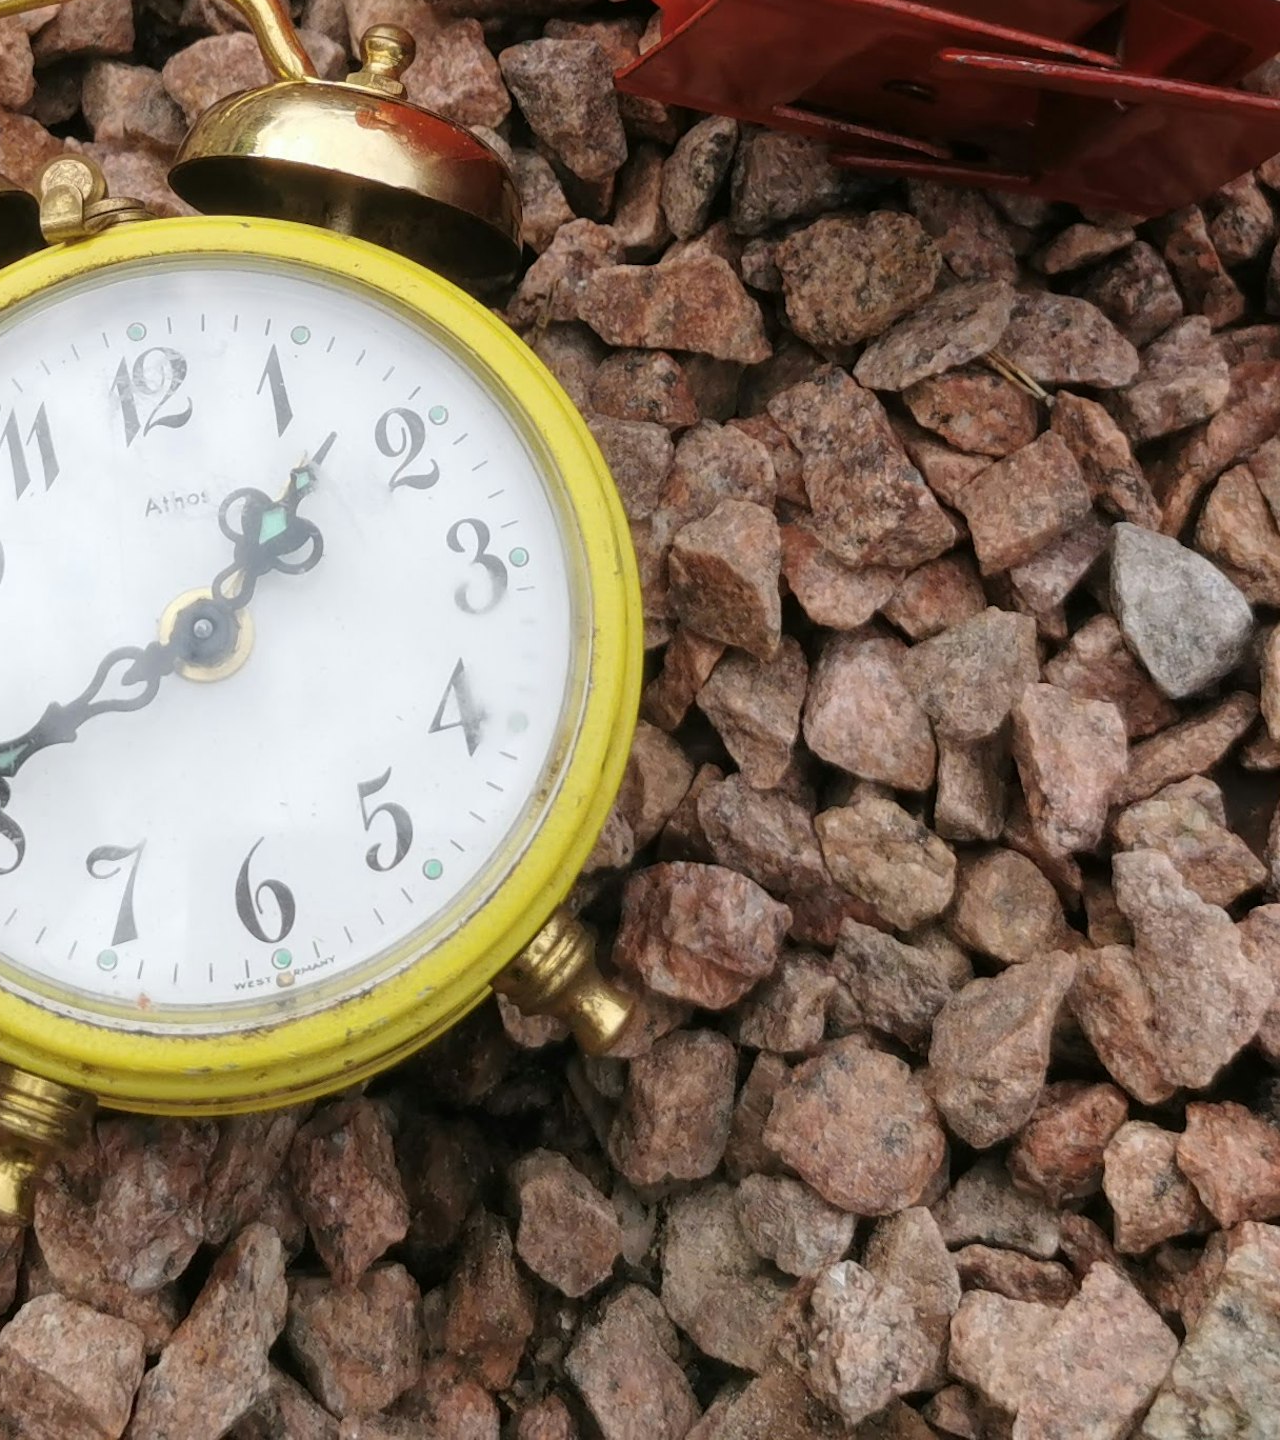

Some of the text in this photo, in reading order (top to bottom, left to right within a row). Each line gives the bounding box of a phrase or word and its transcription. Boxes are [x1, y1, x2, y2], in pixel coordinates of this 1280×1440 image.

[111, 347, 193, 446] 12
[257, 345, 293, 437] 1
[375, 409, 441, 489] 2
[145, 490, 209, 517] Athos
[447, 519, 507, 610] 3
[429, 658, 486, 756] 4
[358, 768, 413, 872] 5
[86, 839, 147, 946] 7
[235, 839, 295, 943] 6
[234, 955, 336, 990] WEST RMANY
